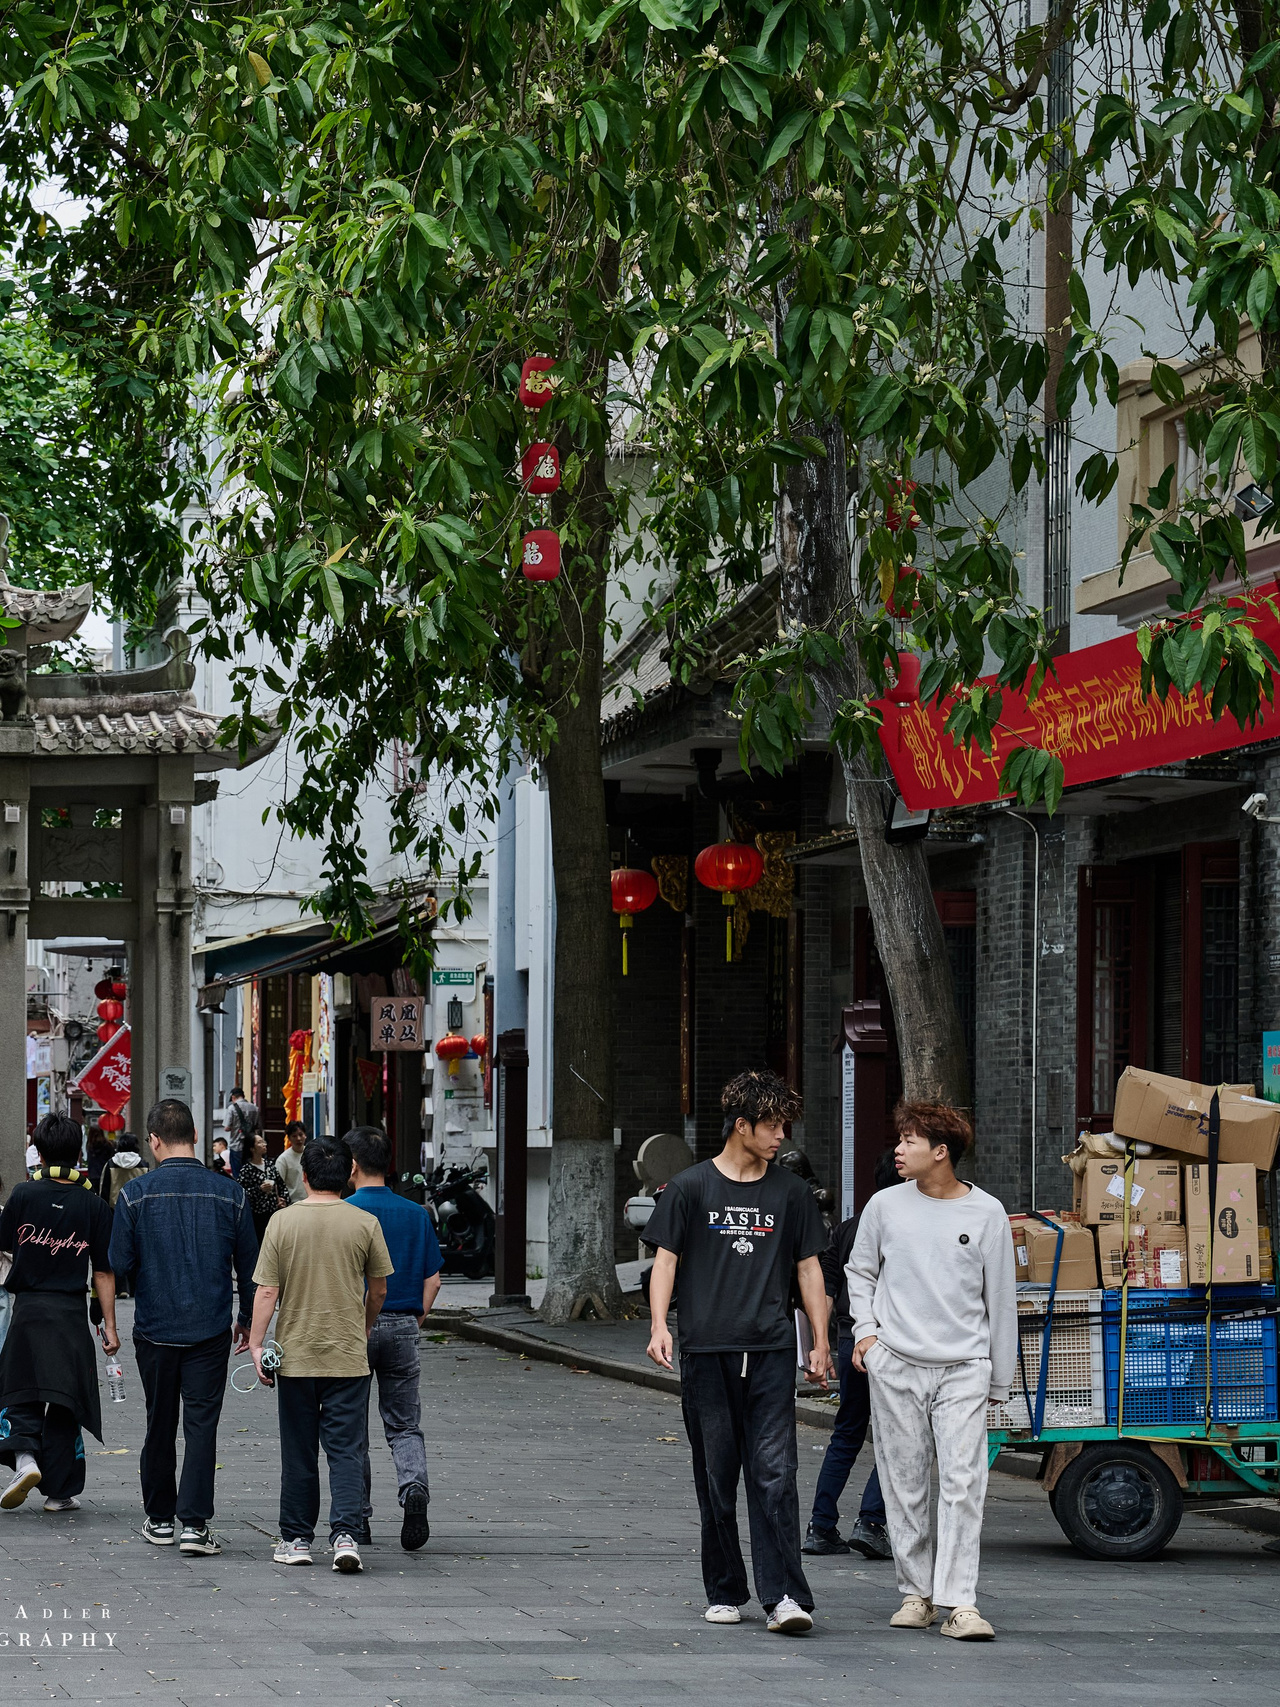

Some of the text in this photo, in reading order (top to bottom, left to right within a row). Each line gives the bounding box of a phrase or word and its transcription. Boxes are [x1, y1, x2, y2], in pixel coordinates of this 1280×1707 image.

[379, 1003, 417, 1022] 凤凰
[379, 1023, 417, 1043] 单丛
[708, 1211, 774, 1227] PASIS
